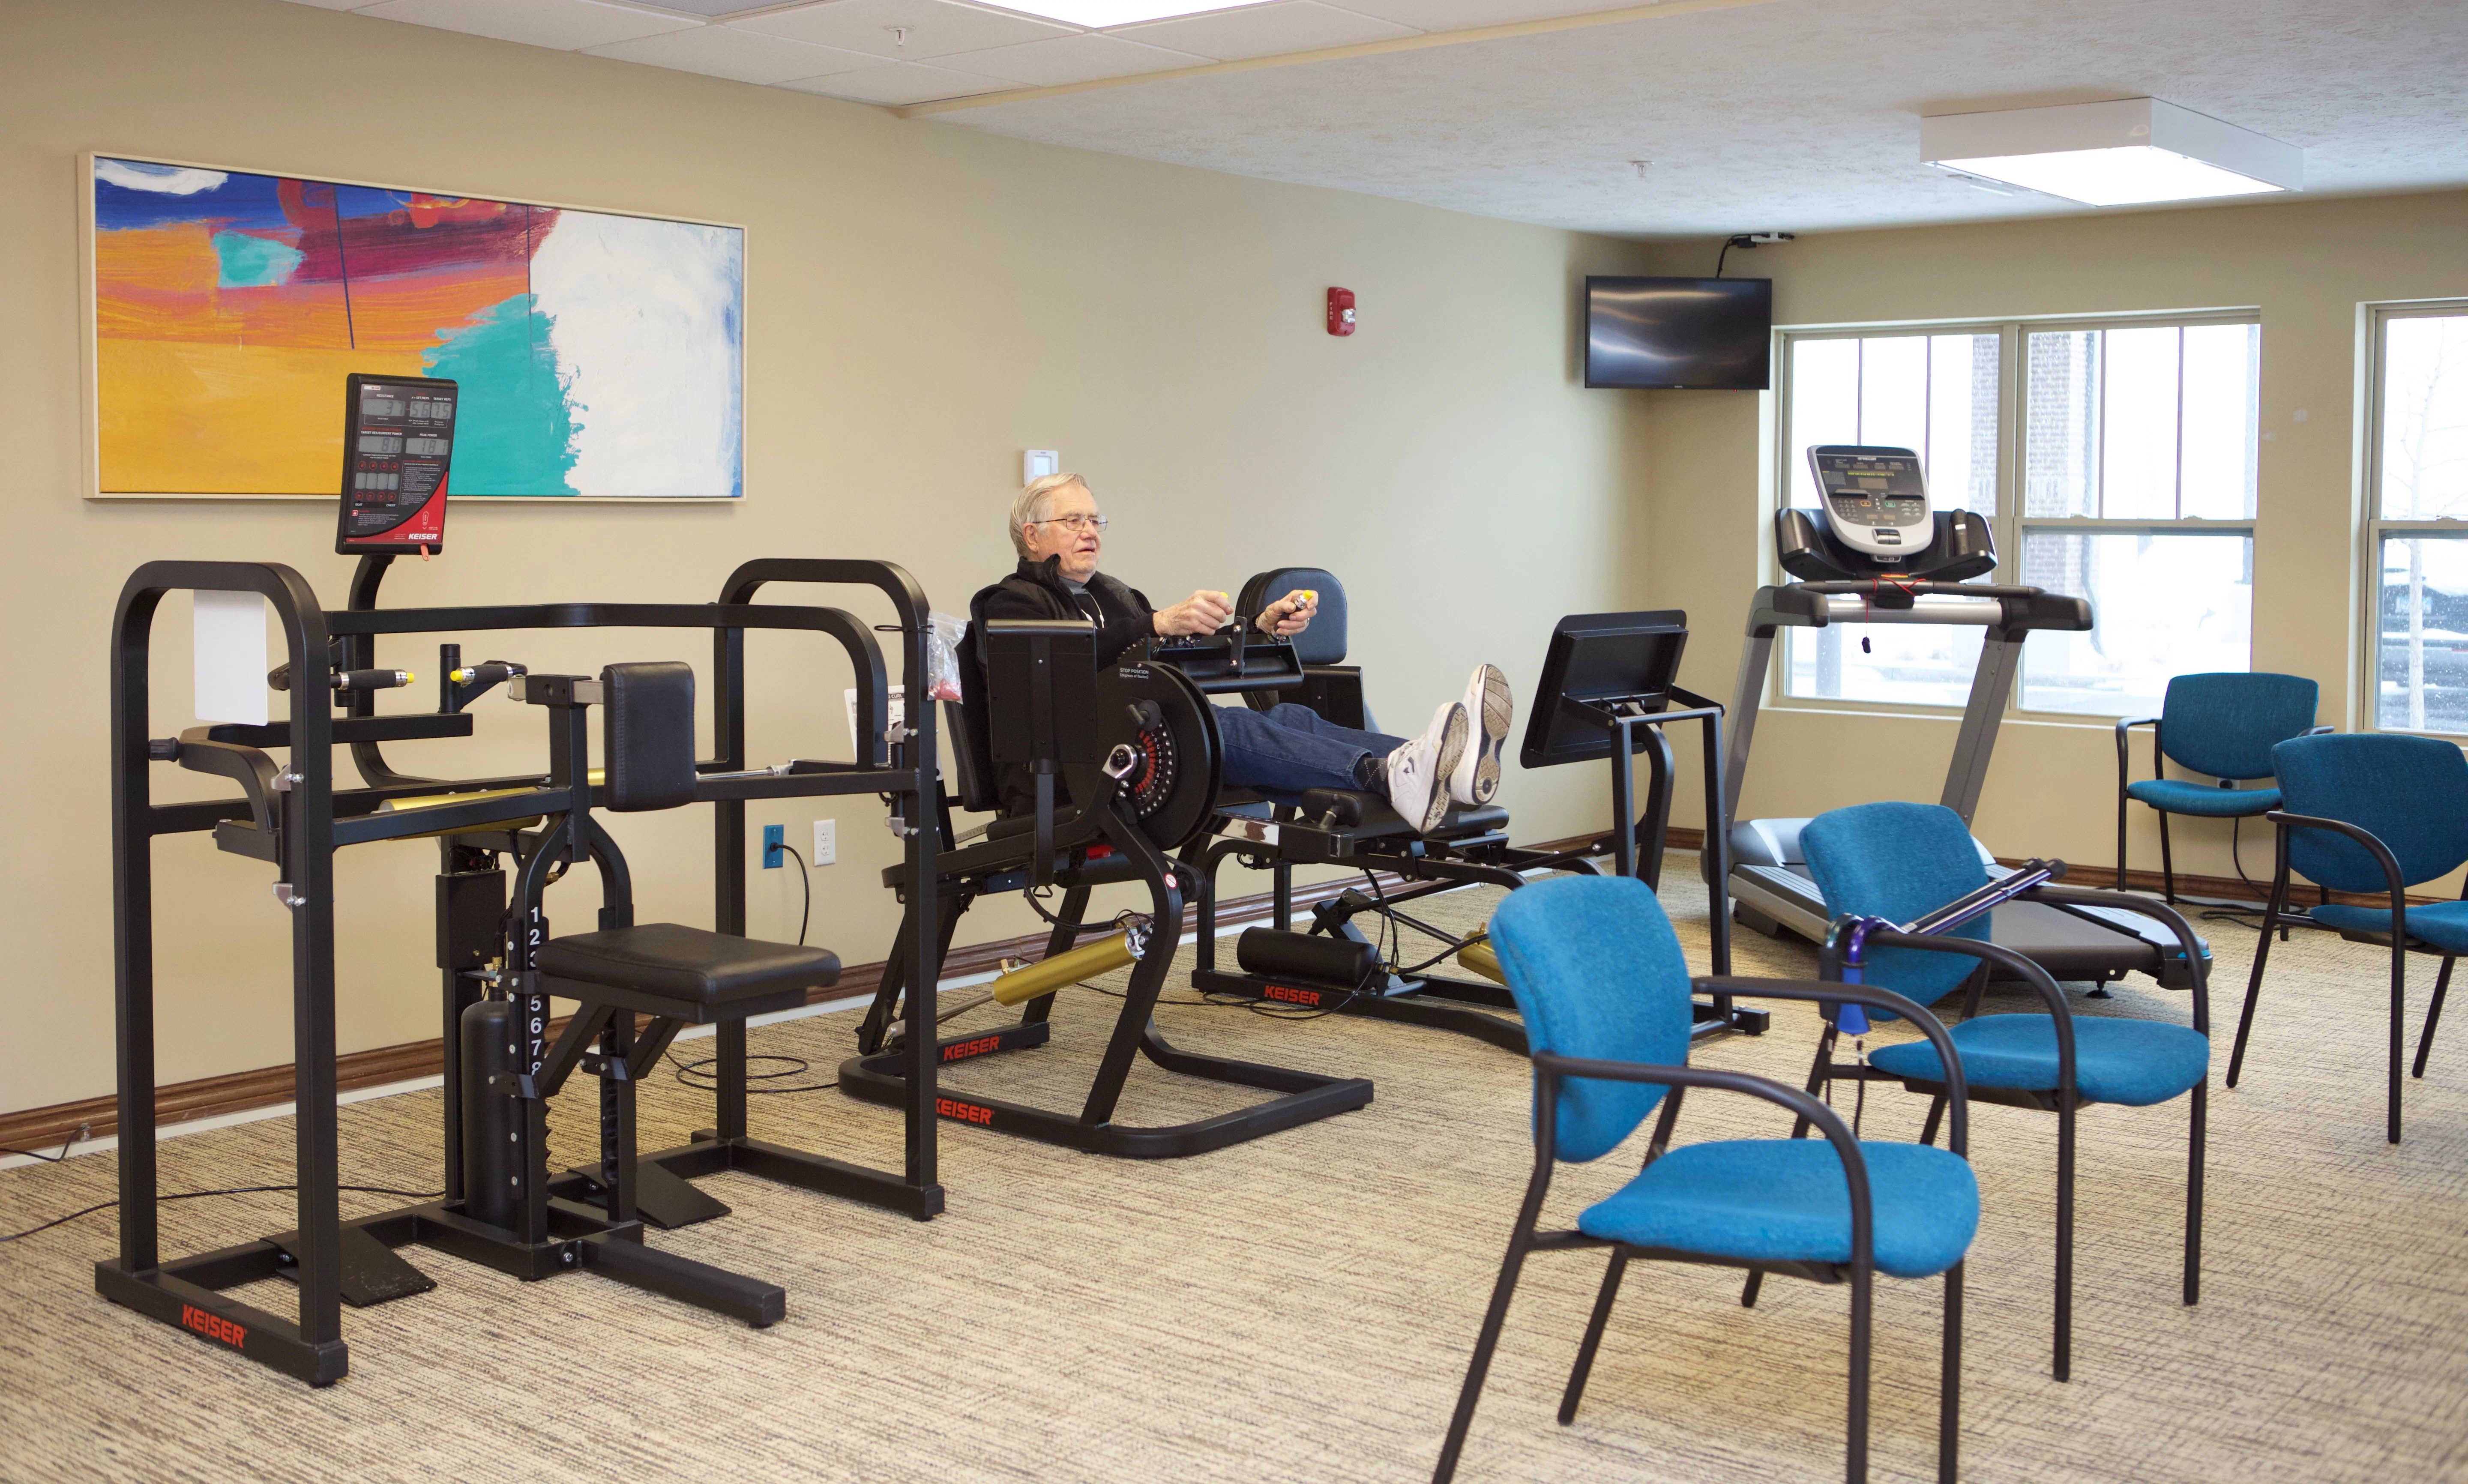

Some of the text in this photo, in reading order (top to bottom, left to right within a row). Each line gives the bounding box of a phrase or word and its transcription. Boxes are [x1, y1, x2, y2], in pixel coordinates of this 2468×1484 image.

[531, 906, 539, 923] 1
[529, 929, 540, 945] 2
[530, 995, 541, 1011] 5
[1264, 985, 1320, 1005] KEISER
[530, 1017, 542, 1034] 6
[531, 1039, 542, 1056] 7
[943, 1036, 1000, 1061] KEISER
[182, 1303, 244, 1349] KEISER
